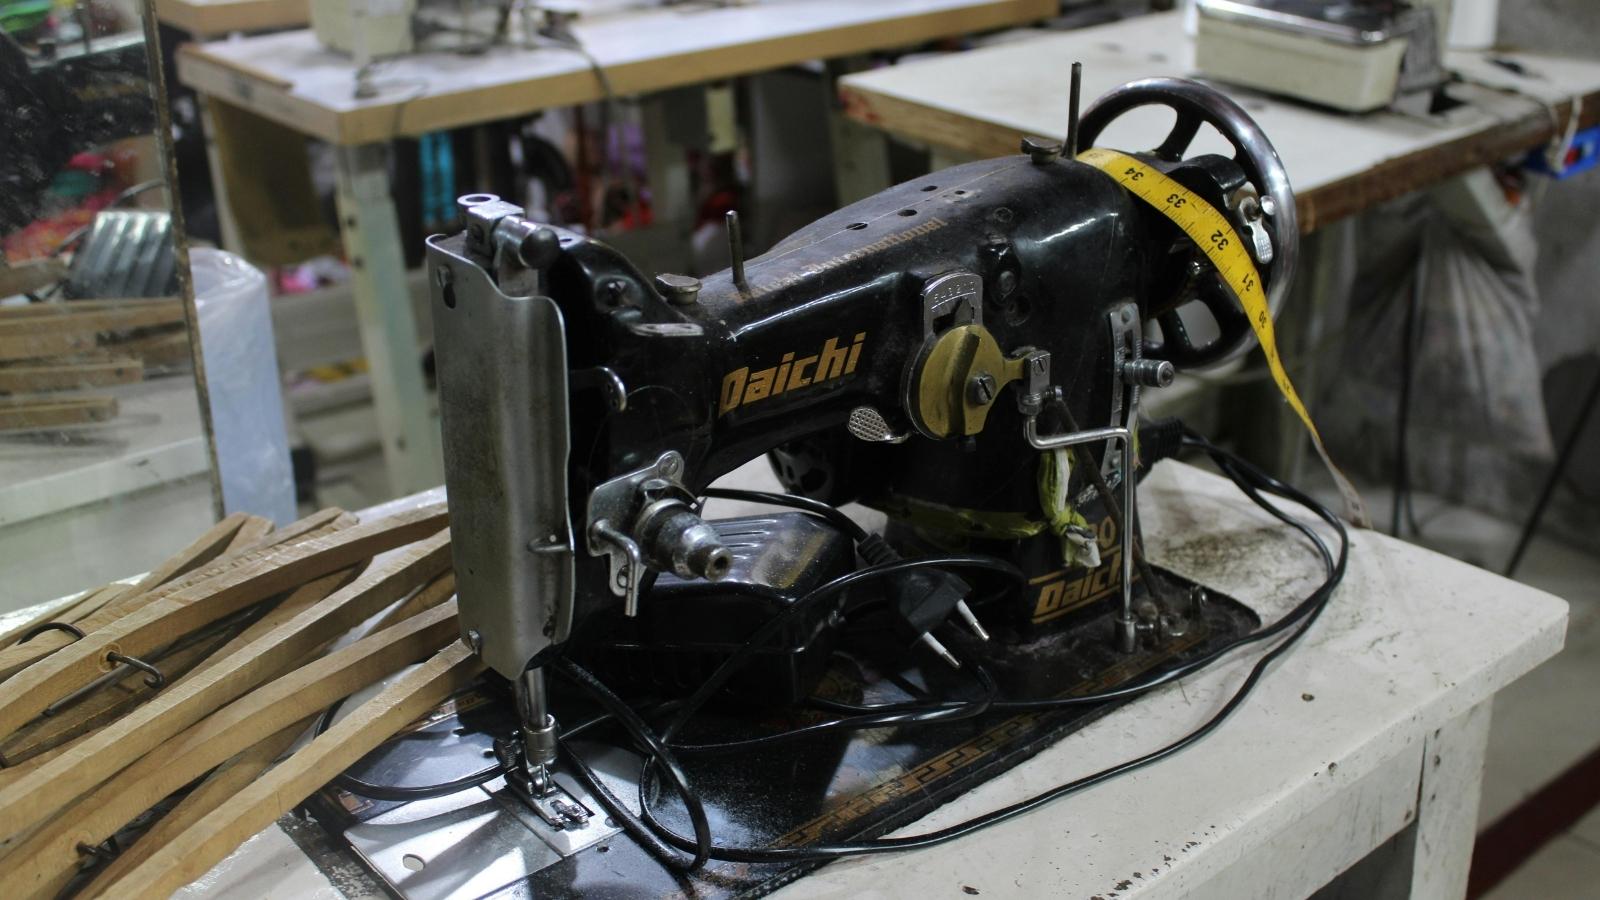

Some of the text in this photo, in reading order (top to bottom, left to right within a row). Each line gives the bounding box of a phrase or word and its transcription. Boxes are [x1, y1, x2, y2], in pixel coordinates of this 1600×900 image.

[1123, 167, 1144, 181] 34
[1166, 193, 1186, 209] 33
[1210, 229, 1229, 251] 32
[1241, 273, 1254, 292] 31
[1258, 310, 1267, 329] 30
[718, 331, 867, 418] Daichi
